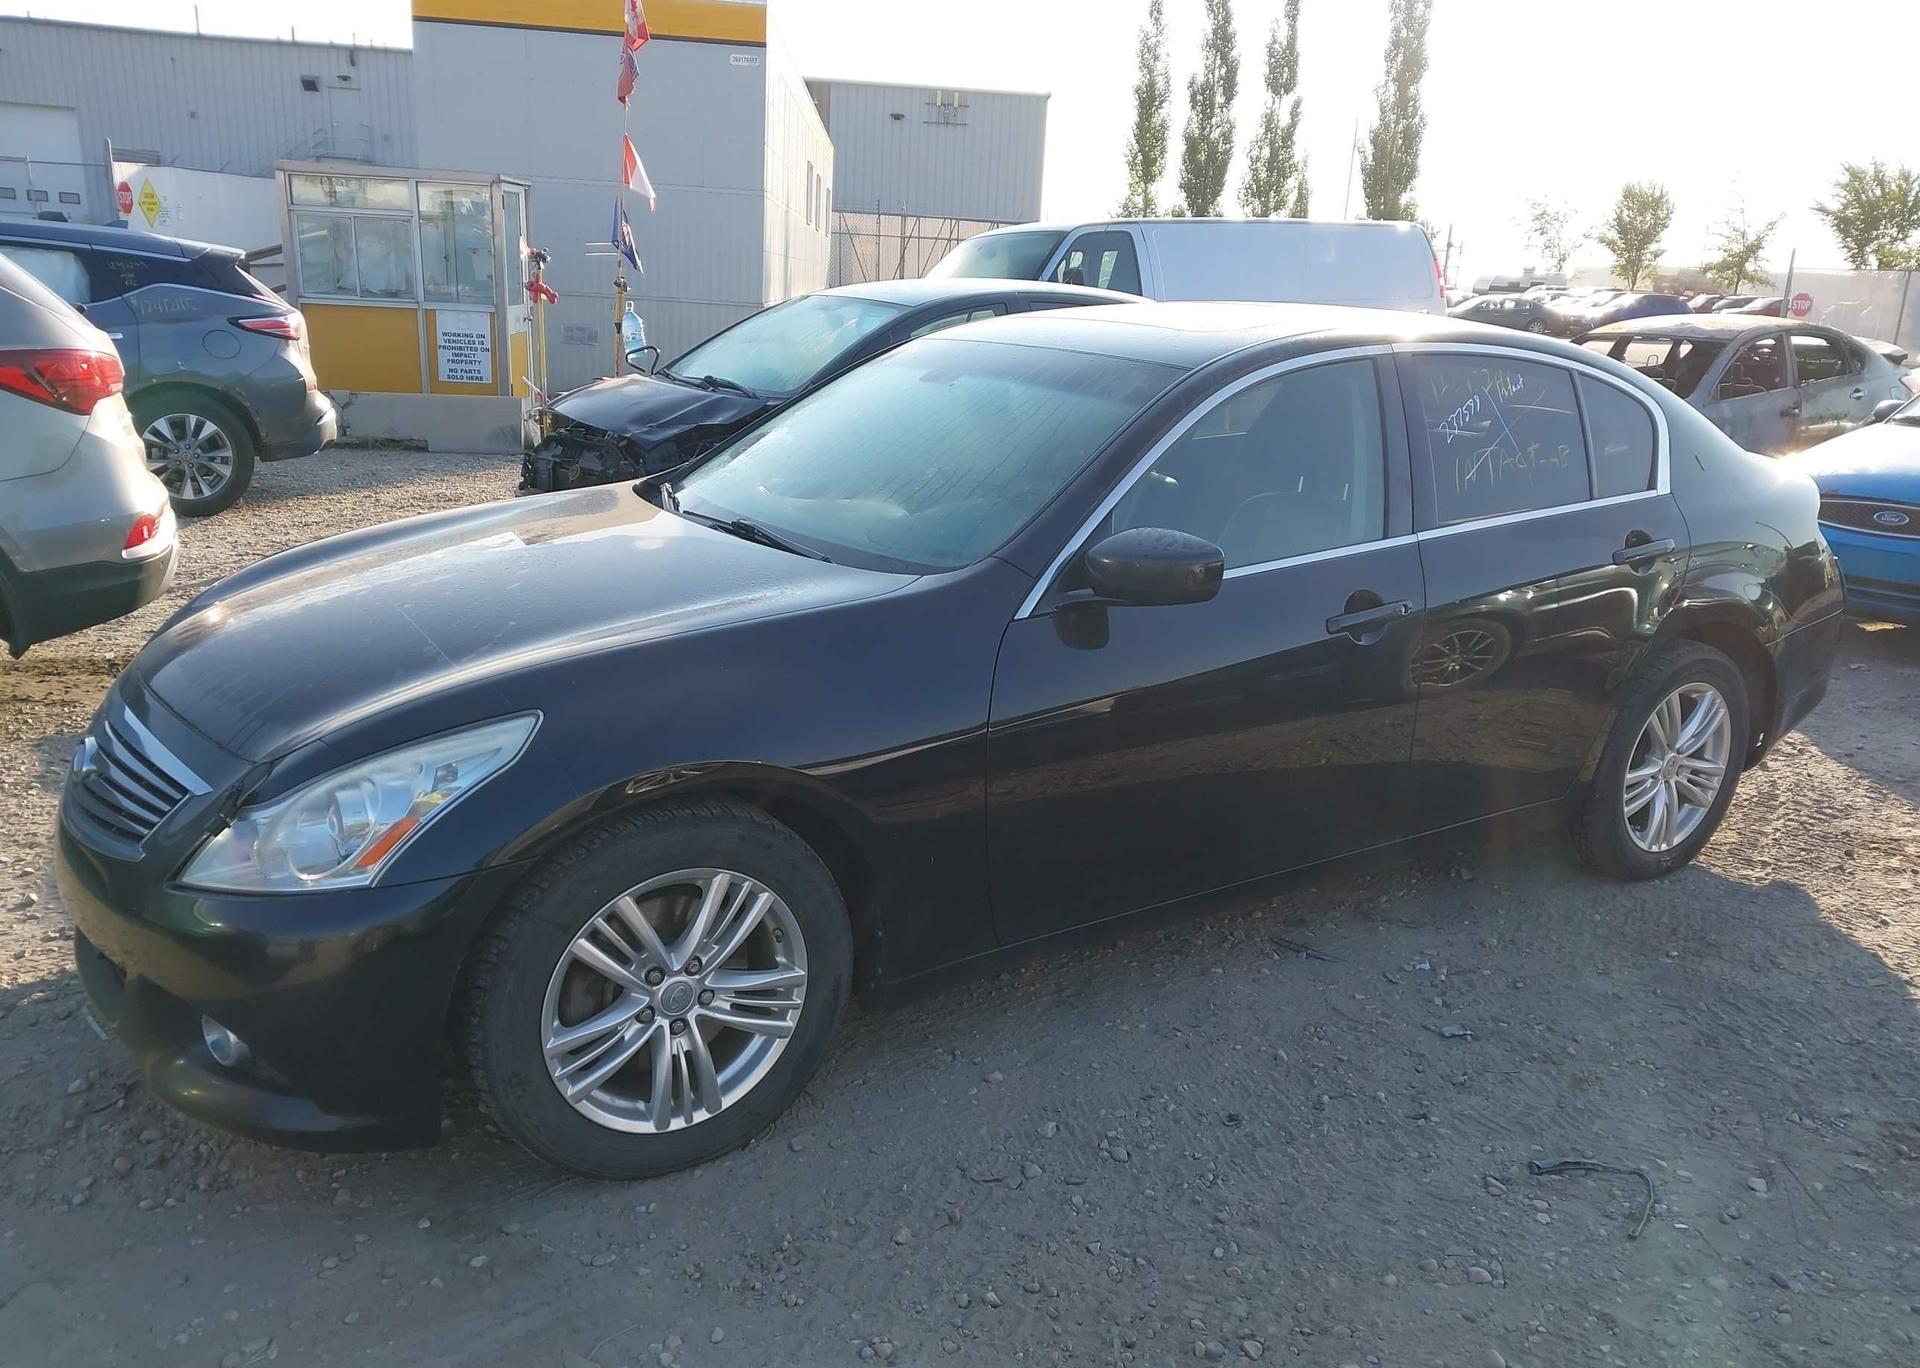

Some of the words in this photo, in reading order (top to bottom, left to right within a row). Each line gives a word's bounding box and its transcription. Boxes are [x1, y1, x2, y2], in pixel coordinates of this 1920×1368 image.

[119, 191, 132, 204] STOP
[1792, 300, 1811, 310] STOP
[441, 331, 474, 339] WORKING
